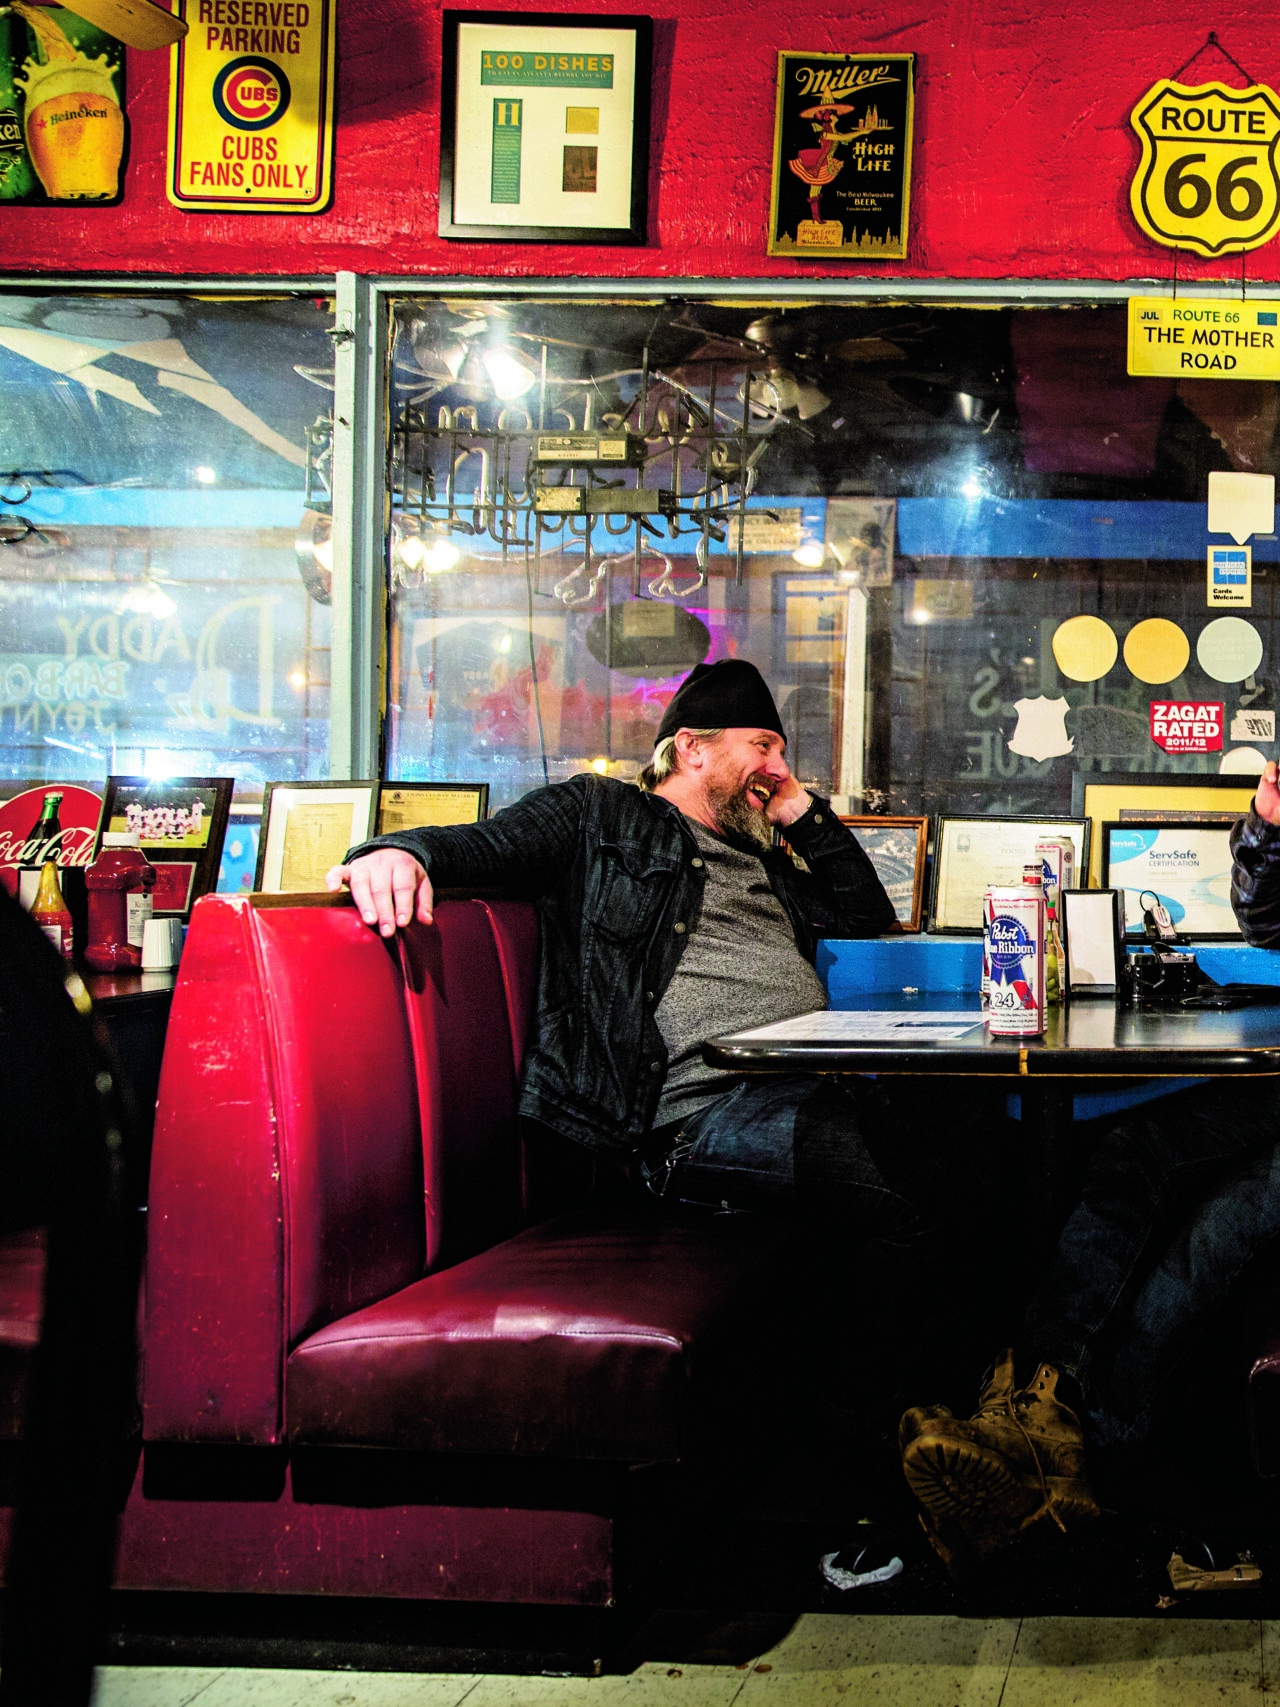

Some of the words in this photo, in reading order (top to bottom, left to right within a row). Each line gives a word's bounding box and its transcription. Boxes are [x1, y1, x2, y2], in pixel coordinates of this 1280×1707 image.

[199, 0, 310, 28] RESERVED
[206, 26, 301, 54] PARKING
[483, 54, 524, 69] 100
[534, 55, 613, 72] DISHES
[796, 64, 890, 97] Miller
[50, 107, 108, 126] Heineken
[1161, 106, 1266, 135] ROUTE
[222, 135, 279, 162] CUBS
[853, 138, 896, 156] HIGH
[855, 155, 892, 172] LIFE
[189, 161, 245, 188] FANS
[252, 163, 309, 189] ONLY
[1164, 153, 1264, 222] 66
[854, 198, 878, 206] BEER
[1140, 311, 1160, 320] JUL
[1173, 309, 1221, 323] ROUTE
[1224, 312, 1240, 323] 66
[1143, 326, 1185, 344] THE
[1191, 329, 1275, 349] MOTHER
[1180, 352, 1237, 370] ROAD
[1153, 705, 1220, 721] ZAGAT
[1153, 721, 1220, 737] RATED
[1165, 738, 1206, 746] 2011/12
[1149, 850, 1197, 860] ServSafe
[991, 922, 1019, 940] Pabst
[998, 940, 1035, 954] Ribbon
[994, 992, 1015, 1009] 24
